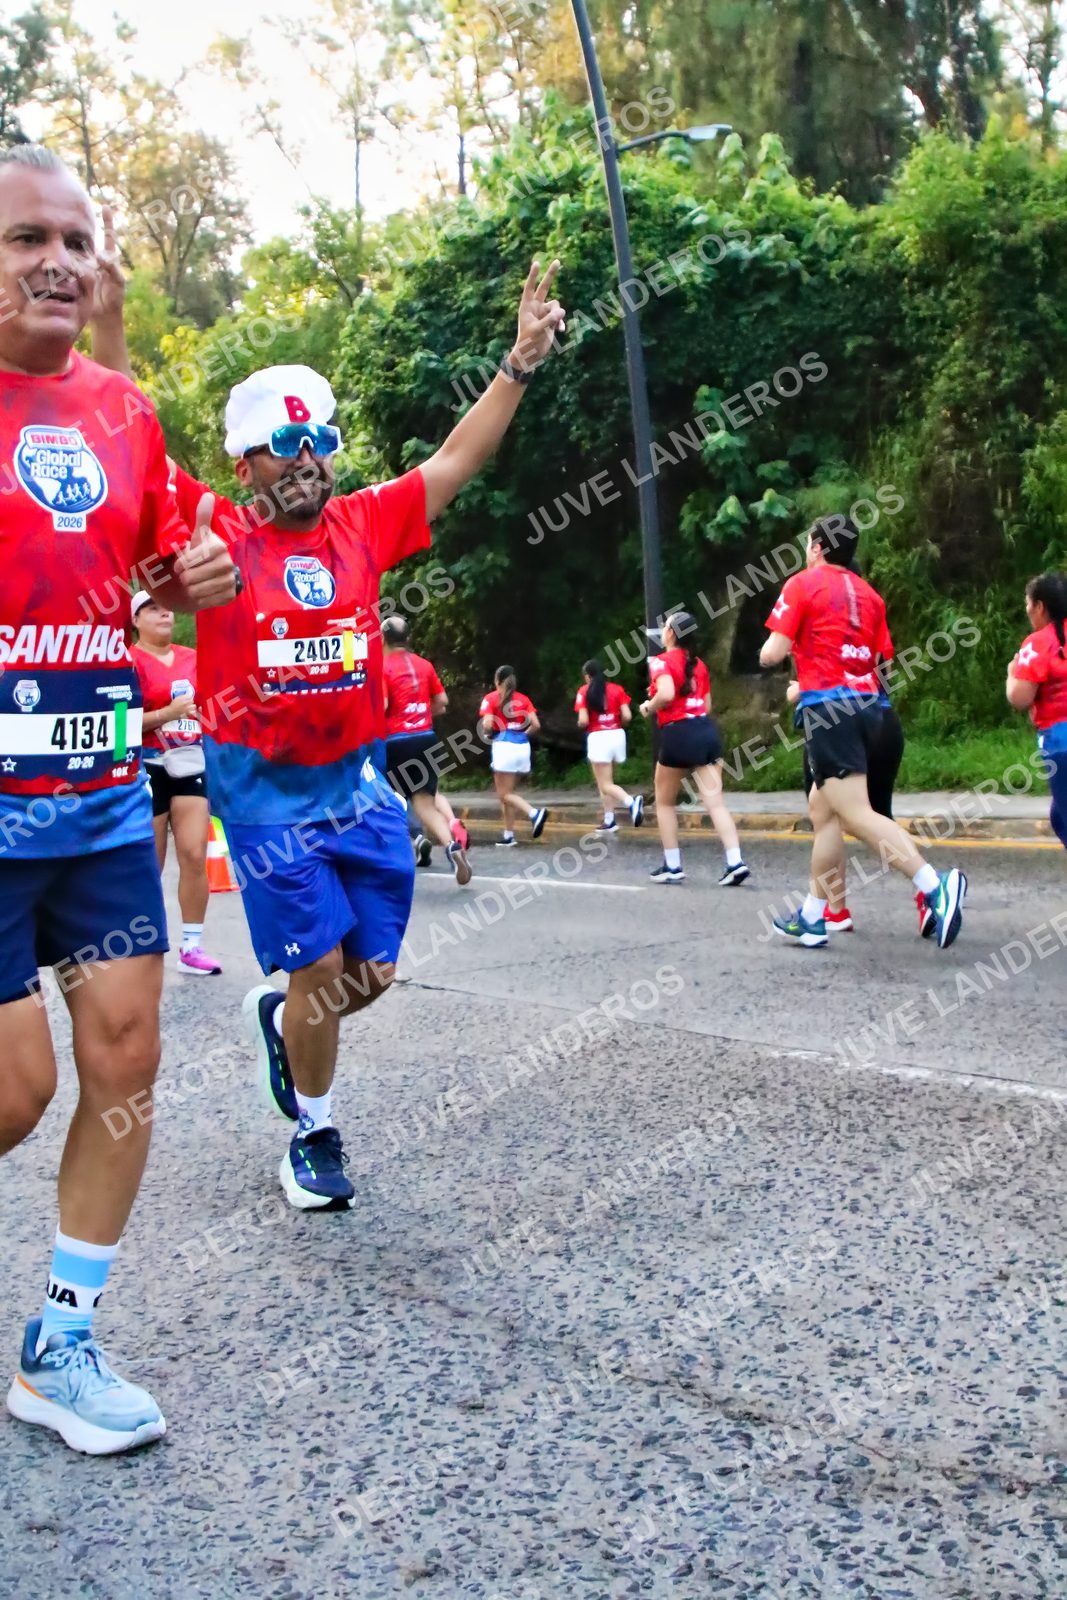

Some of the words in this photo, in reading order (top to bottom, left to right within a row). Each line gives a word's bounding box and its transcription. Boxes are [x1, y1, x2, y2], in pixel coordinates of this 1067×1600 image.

[284, 395, 311, 423] B
[30, 434, 78, 446] BIMBO
[36, 449, 82, 467] Global
[30, 462, 68, 480] Race
[57, 516, 83, 529] 2026
[294, 638, 341, 662] 2402
[51, 715, 108, 750] 4134
